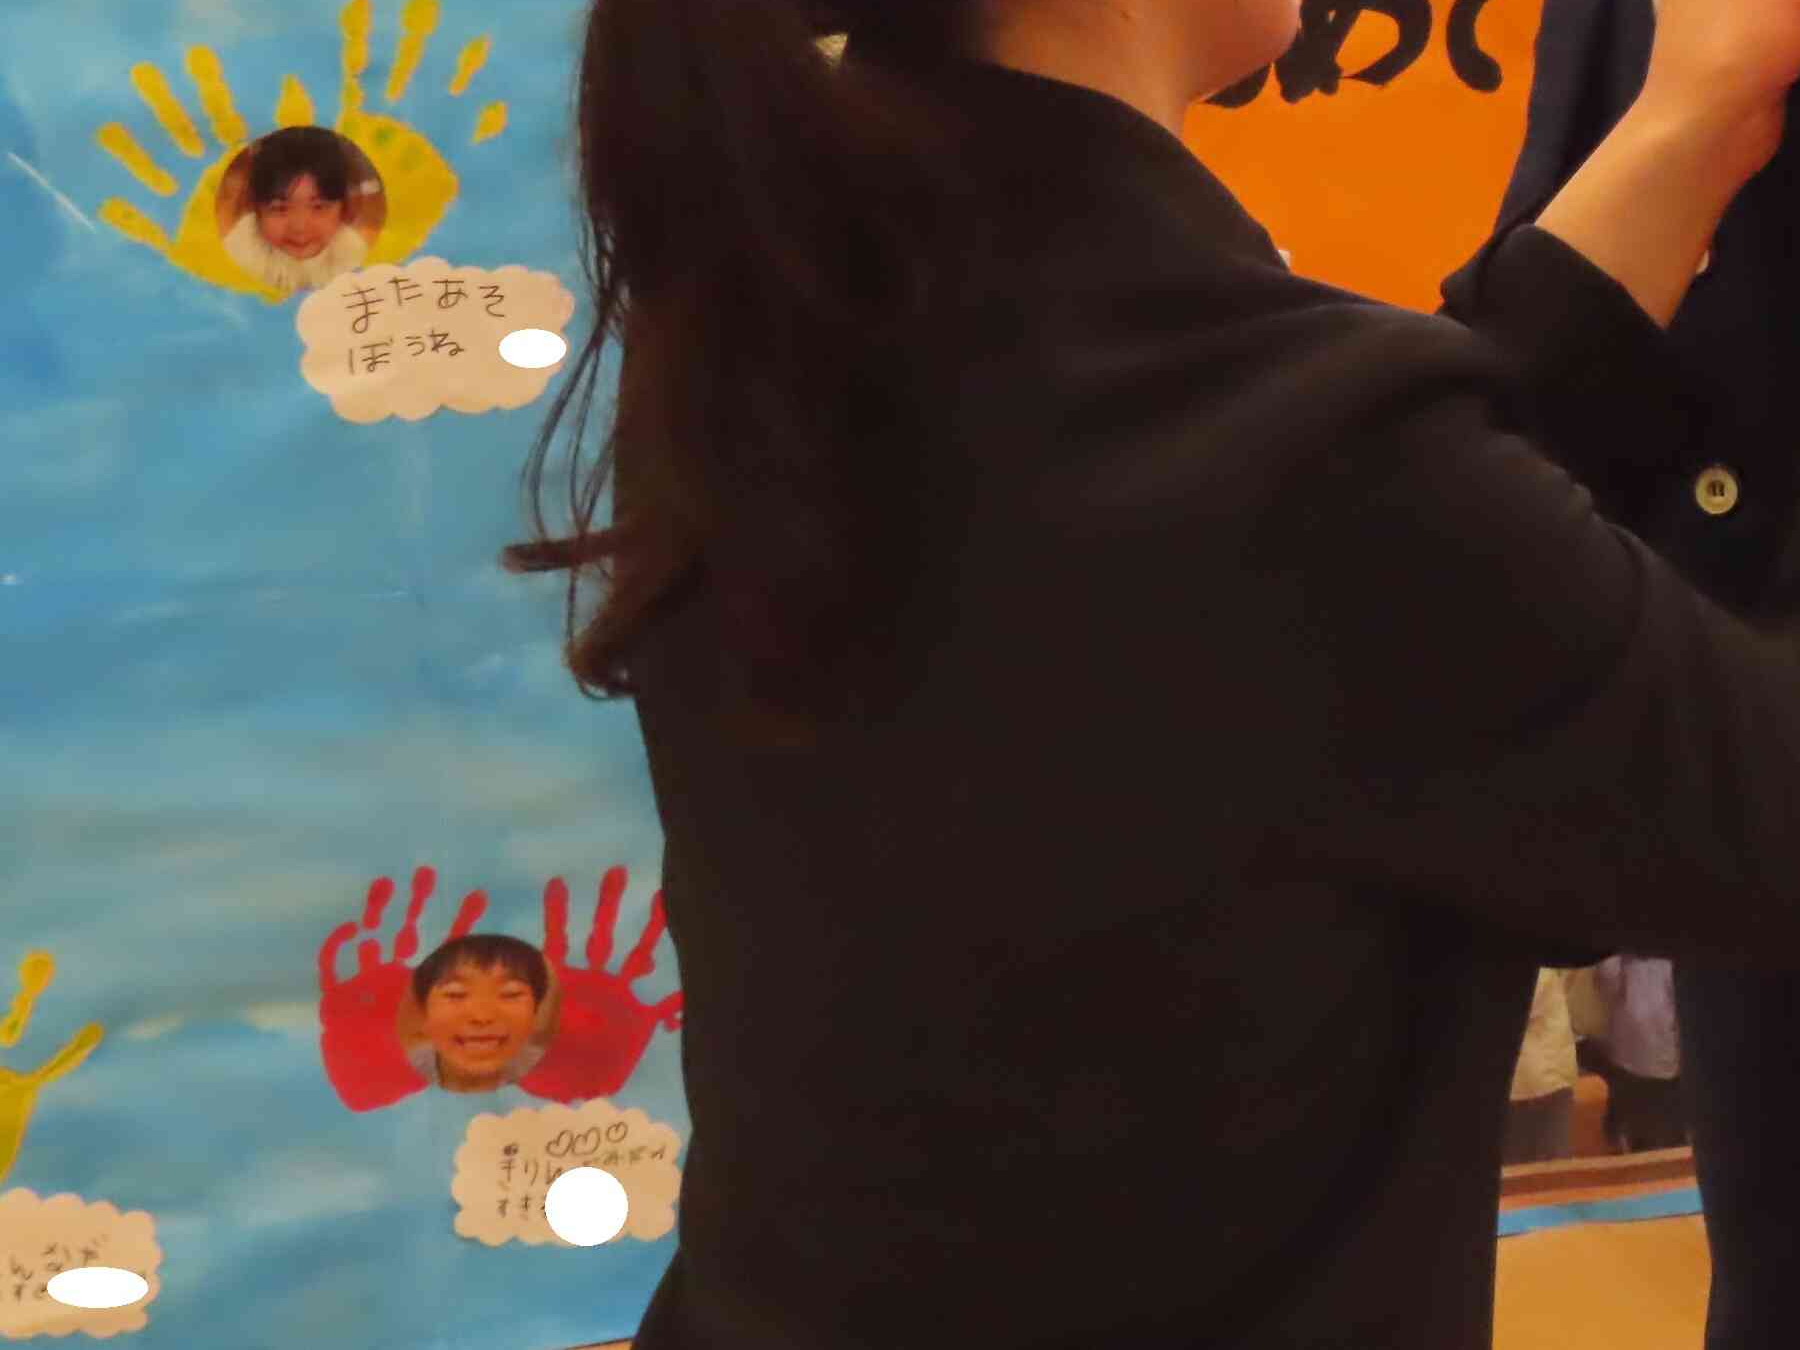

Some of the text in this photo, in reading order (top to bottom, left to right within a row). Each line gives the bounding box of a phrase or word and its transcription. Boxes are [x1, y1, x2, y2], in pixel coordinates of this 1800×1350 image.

[342, 276, 506, 334] またあそ
[348, 326, 465, 375] ぼうね
